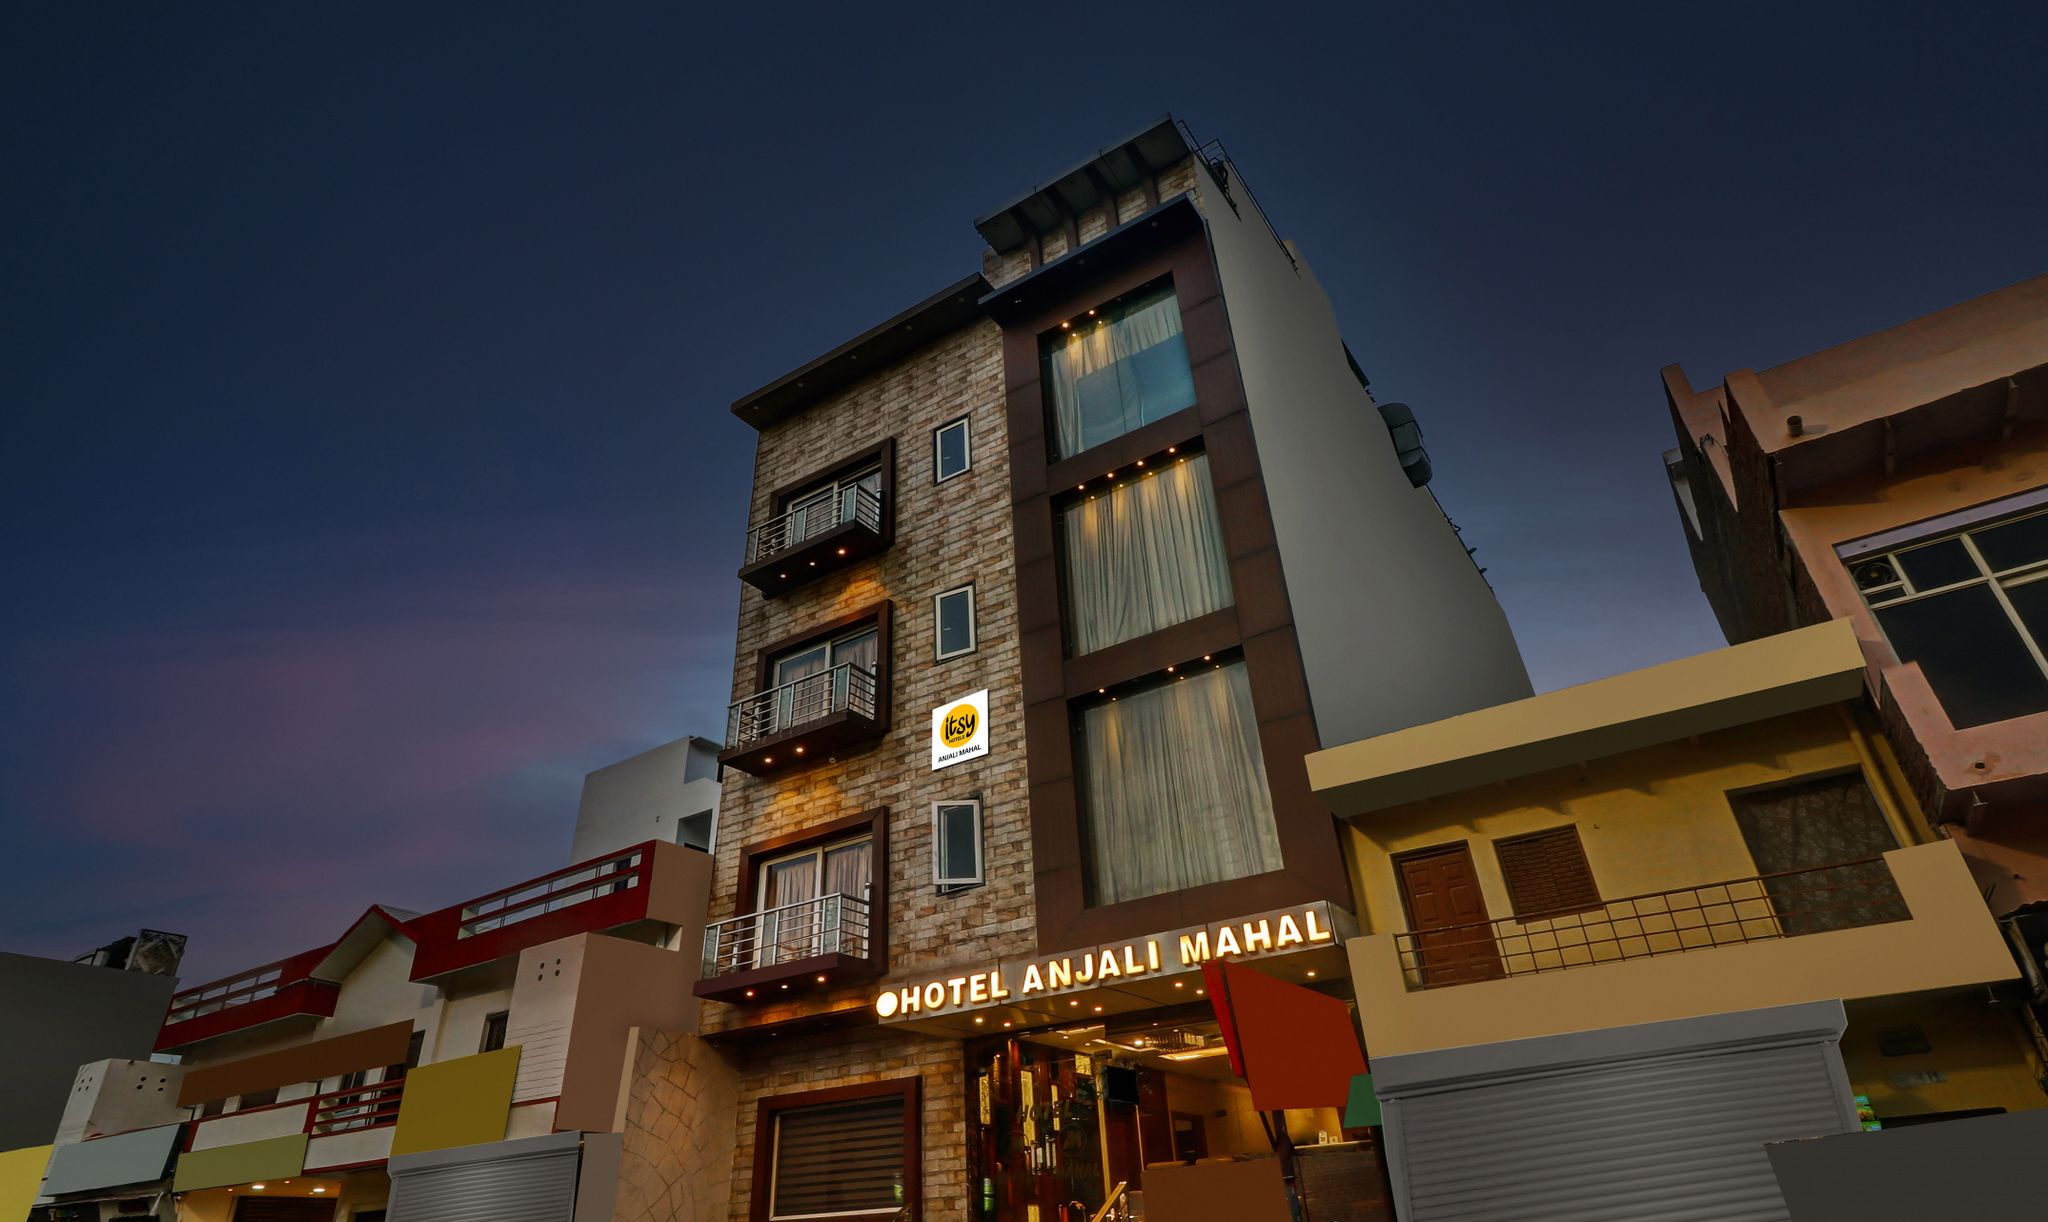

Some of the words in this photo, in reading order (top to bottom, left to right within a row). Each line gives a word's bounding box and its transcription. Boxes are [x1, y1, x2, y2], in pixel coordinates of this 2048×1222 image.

[945, 713, 976, 741] itsy
[948, 735, 966, 744] HOTELS
[938, 751, 959, 763] ANJALI
[959, 744, 982, 757] MAHAL
[900, 970, 1009, 1015] HOTEL
[1022, 940, 1160, 994] ANJALI
[1179, 910, 1332, 965] MAHAL
